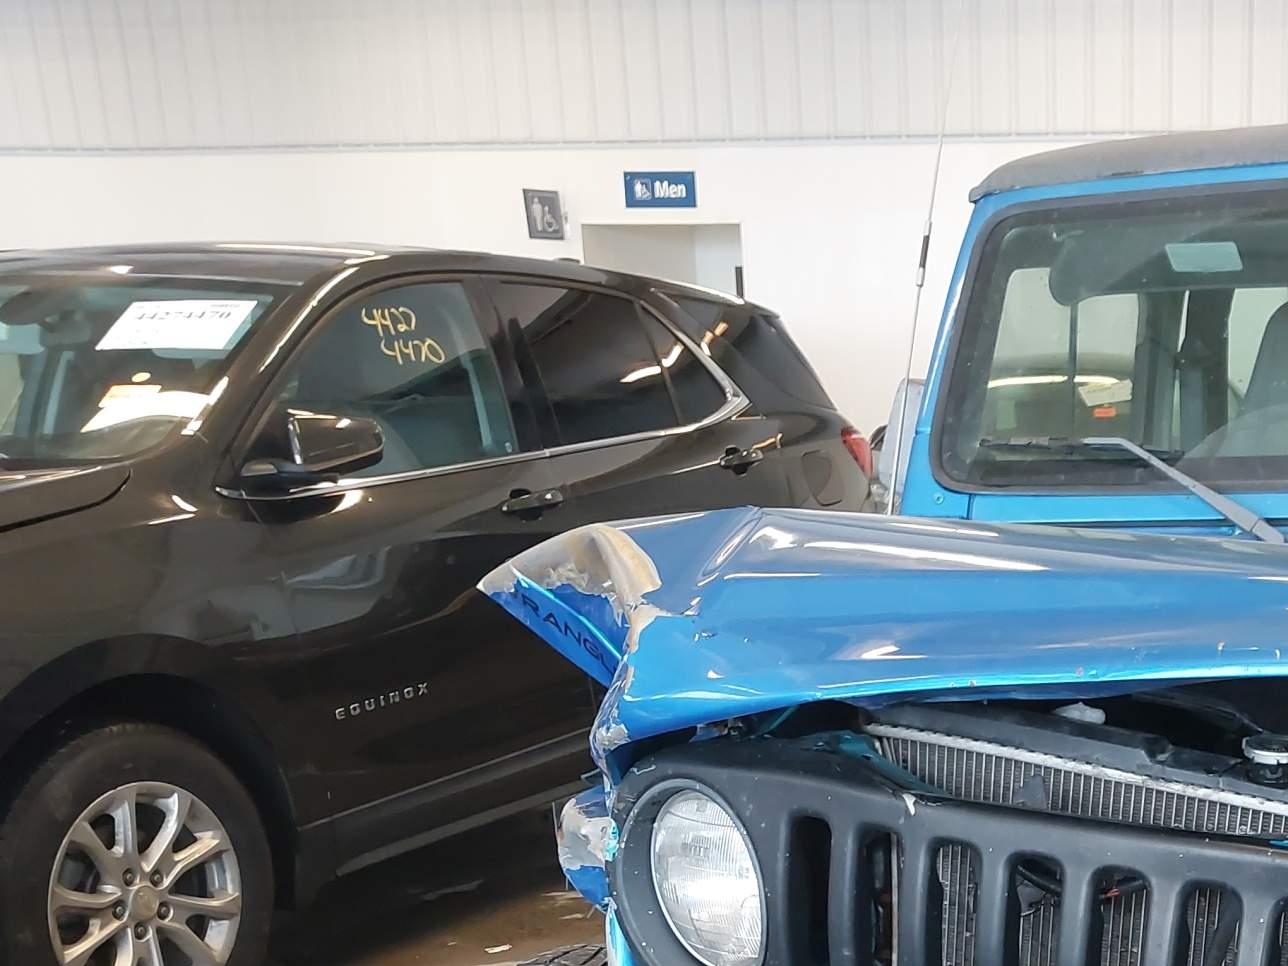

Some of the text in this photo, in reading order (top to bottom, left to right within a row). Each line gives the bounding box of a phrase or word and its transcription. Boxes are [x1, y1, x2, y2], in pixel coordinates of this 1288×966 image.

[653, 180, 687, 199] Men
[361, 306, 416, 337] 4427
[380, 338, 445, 365] 4470
[335, 682, 428, 720] EQUINOX
